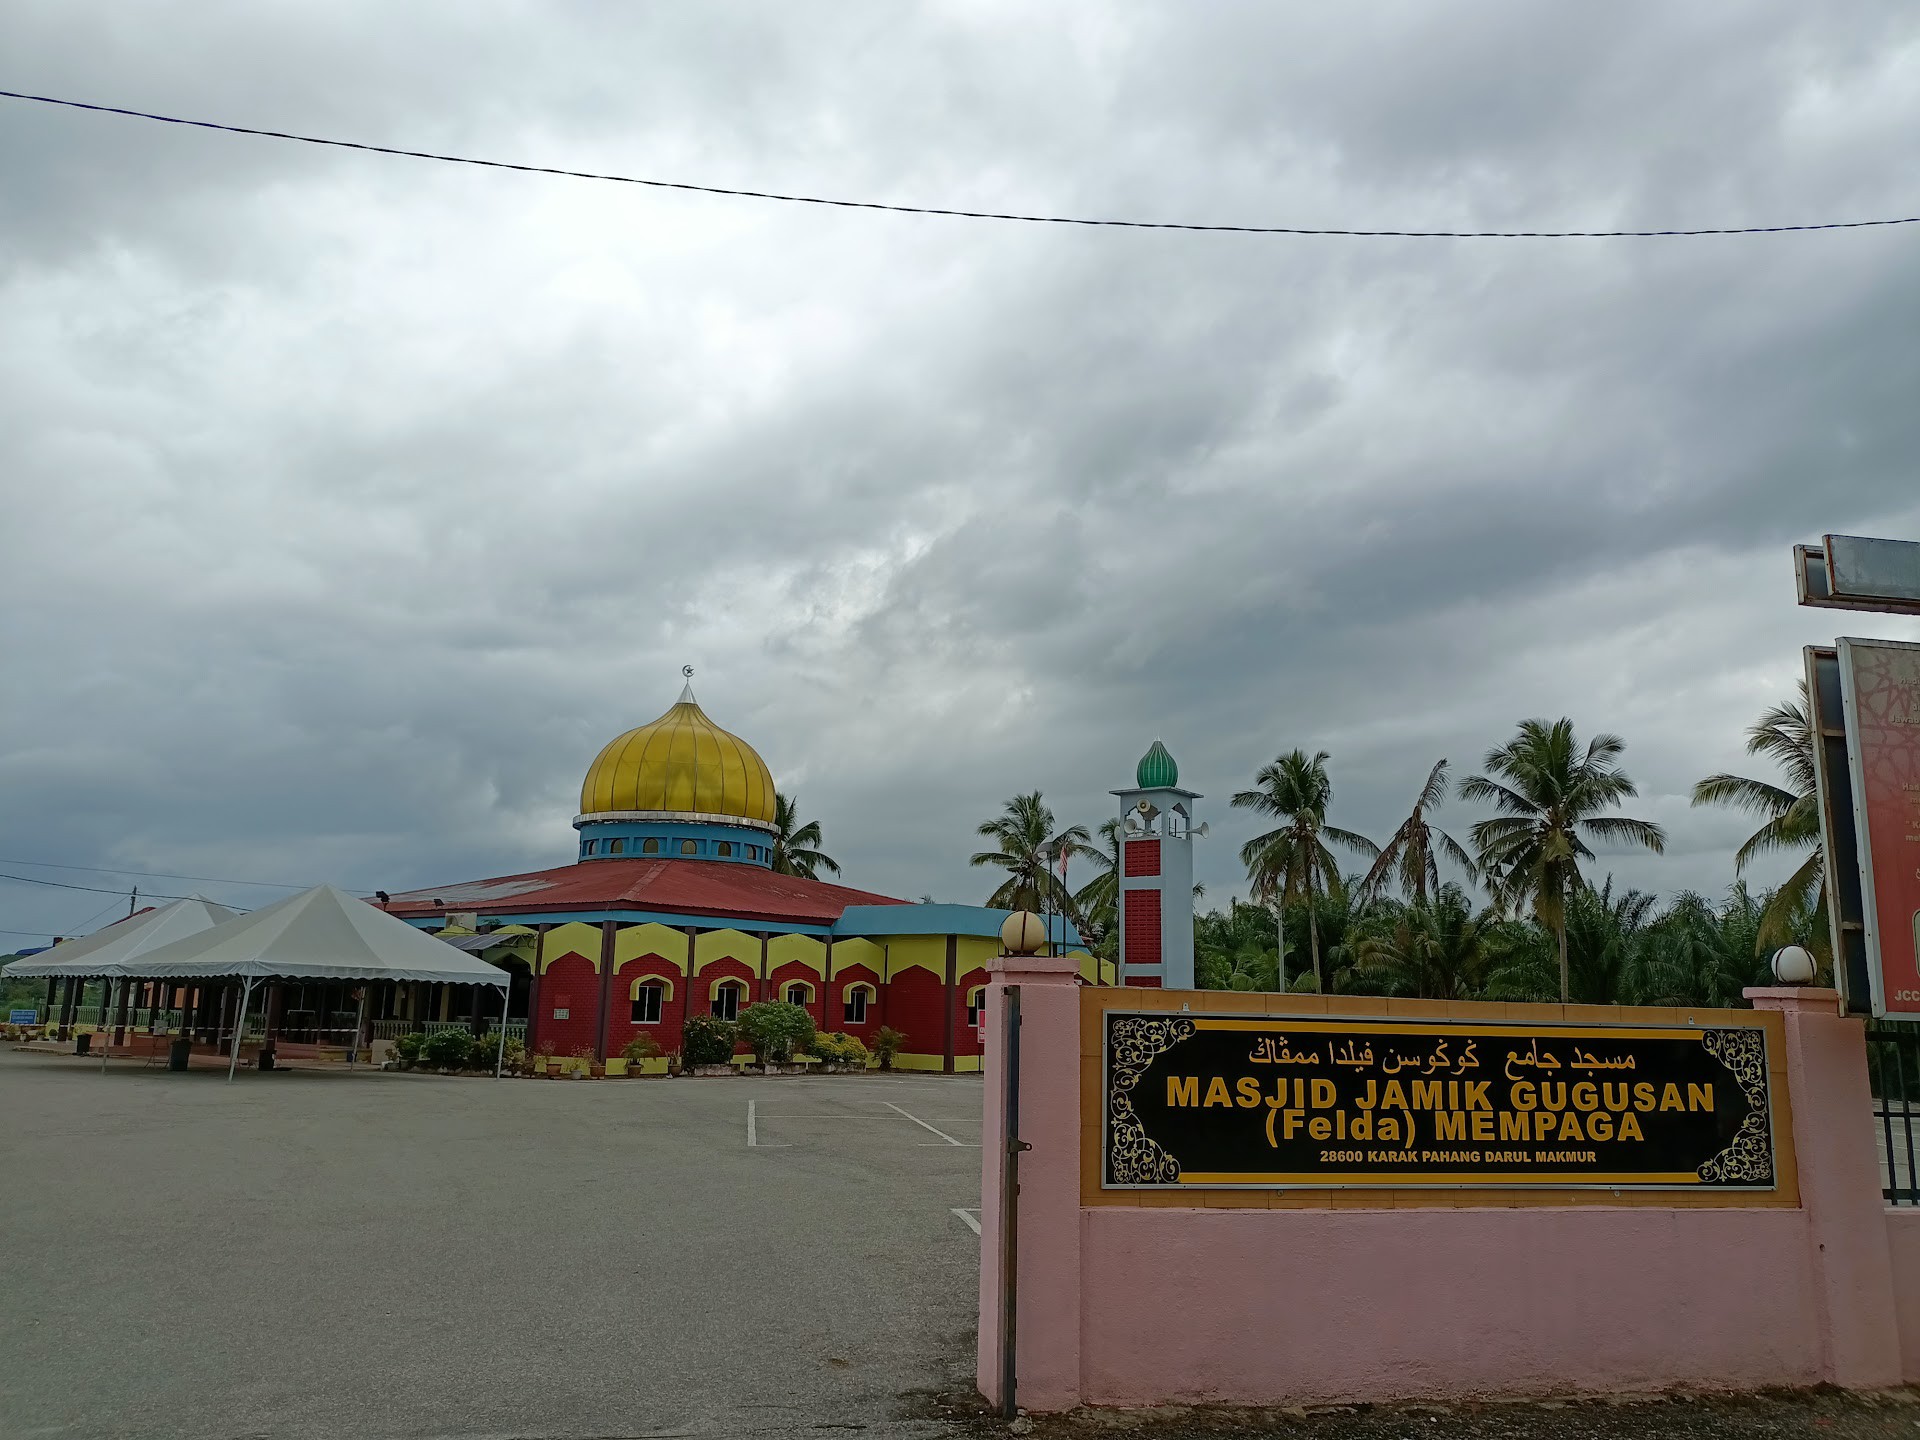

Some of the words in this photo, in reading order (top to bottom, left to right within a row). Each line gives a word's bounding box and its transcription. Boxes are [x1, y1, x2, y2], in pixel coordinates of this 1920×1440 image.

[1328, 1039, 1374, 1073] فيلدا
[1504, 1037, 1562, 1081] جامع
[1571, 1046, 1636, 1078] مسجد
[1166, 1075, 1337, 1109] MASJID
[1354, 1079, 1494, 1111] JAMIK
[1509, 1080, 1715, 1112] GUGUSAN
[1265, 1108, 1416, 1149] (Felda)
[1434, 1110, 1645, 1142] MEMPAGA
[1319, 1150, 1364, 1163] 28600
[1367, 1150, 1419, 1163] KARAK
[1421, 1150, 1481, 1163] PAHANG
[1484, 1150, 1532, 1163] DARUL
[1535, 1150, 1597, 1163] MAKMUR
